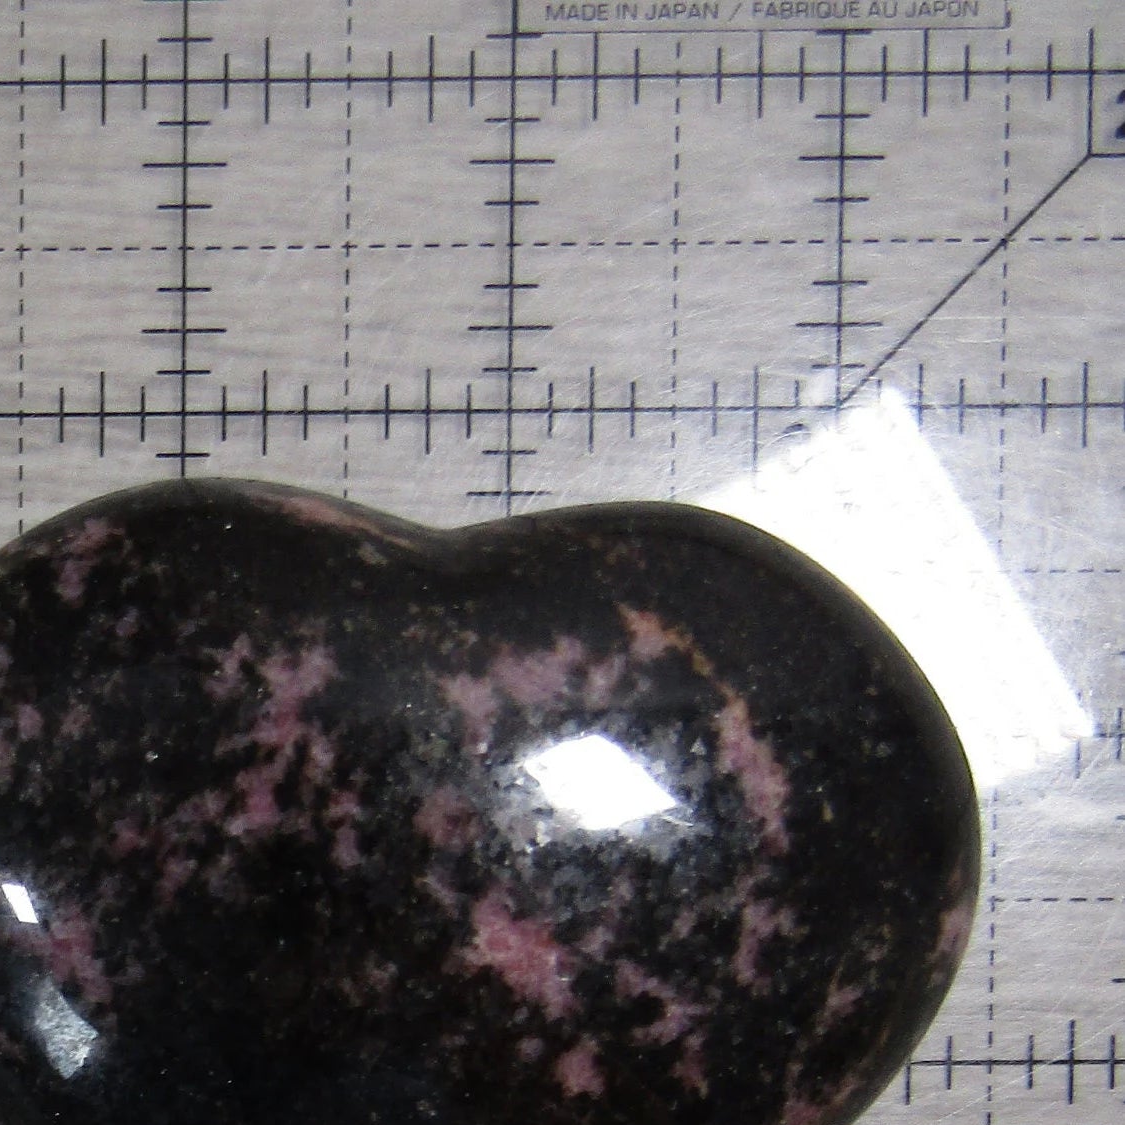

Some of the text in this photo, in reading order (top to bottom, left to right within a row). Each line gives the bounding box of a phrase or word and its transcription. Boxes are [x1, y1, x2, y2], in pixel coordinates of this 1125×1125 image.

[545, 4, 608, 21] MADE
[616, 4, 637, 20] IN
[645, 3, 719, 20] JAPAN
[868, 1, 897, 18] AU
[905, 1, 979, 17] JAPON
